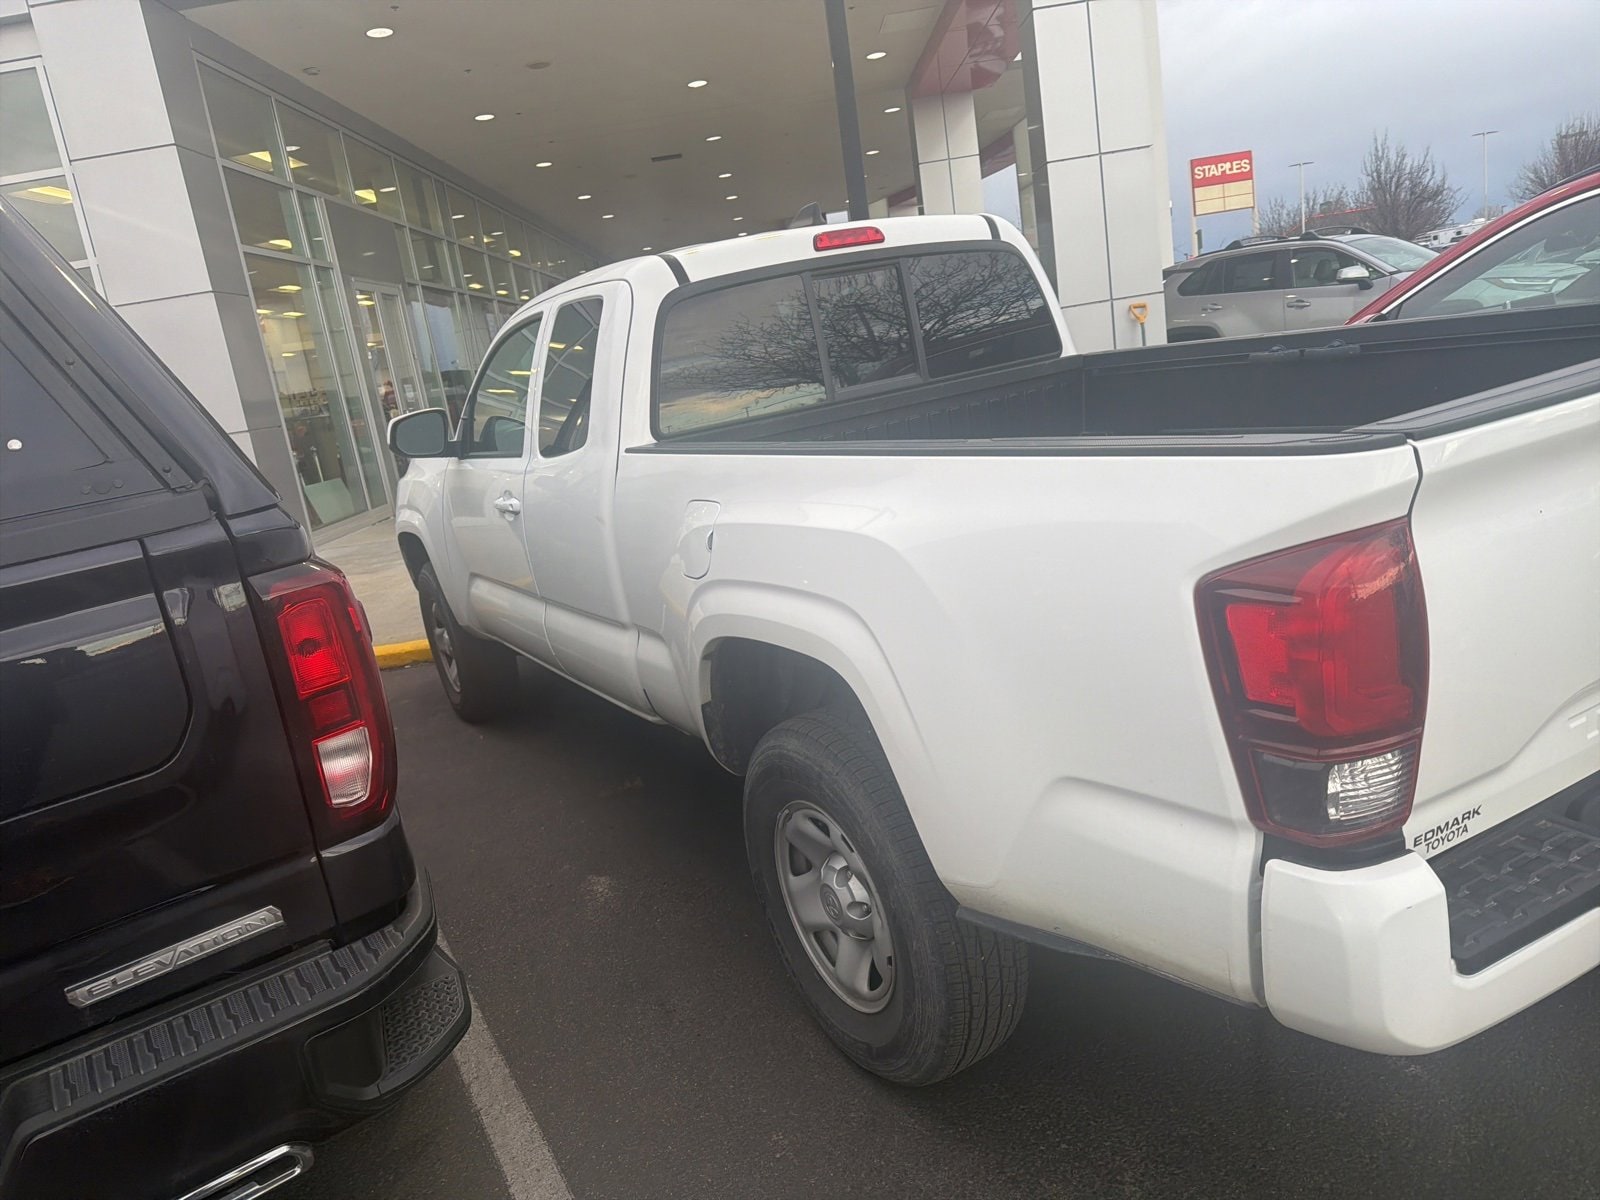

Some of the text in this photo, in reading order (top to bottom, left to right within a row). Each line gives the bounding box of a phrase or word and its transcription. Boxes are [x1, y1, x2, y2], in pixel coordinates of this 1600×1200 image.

[1194, 159, 1251, 180] STAPLES
[1413, 804, 1482, 848] EDMARK
[1424, 823, 1469, 854] TOYOTA
[86, 914, 269, 998] ELEVATION
